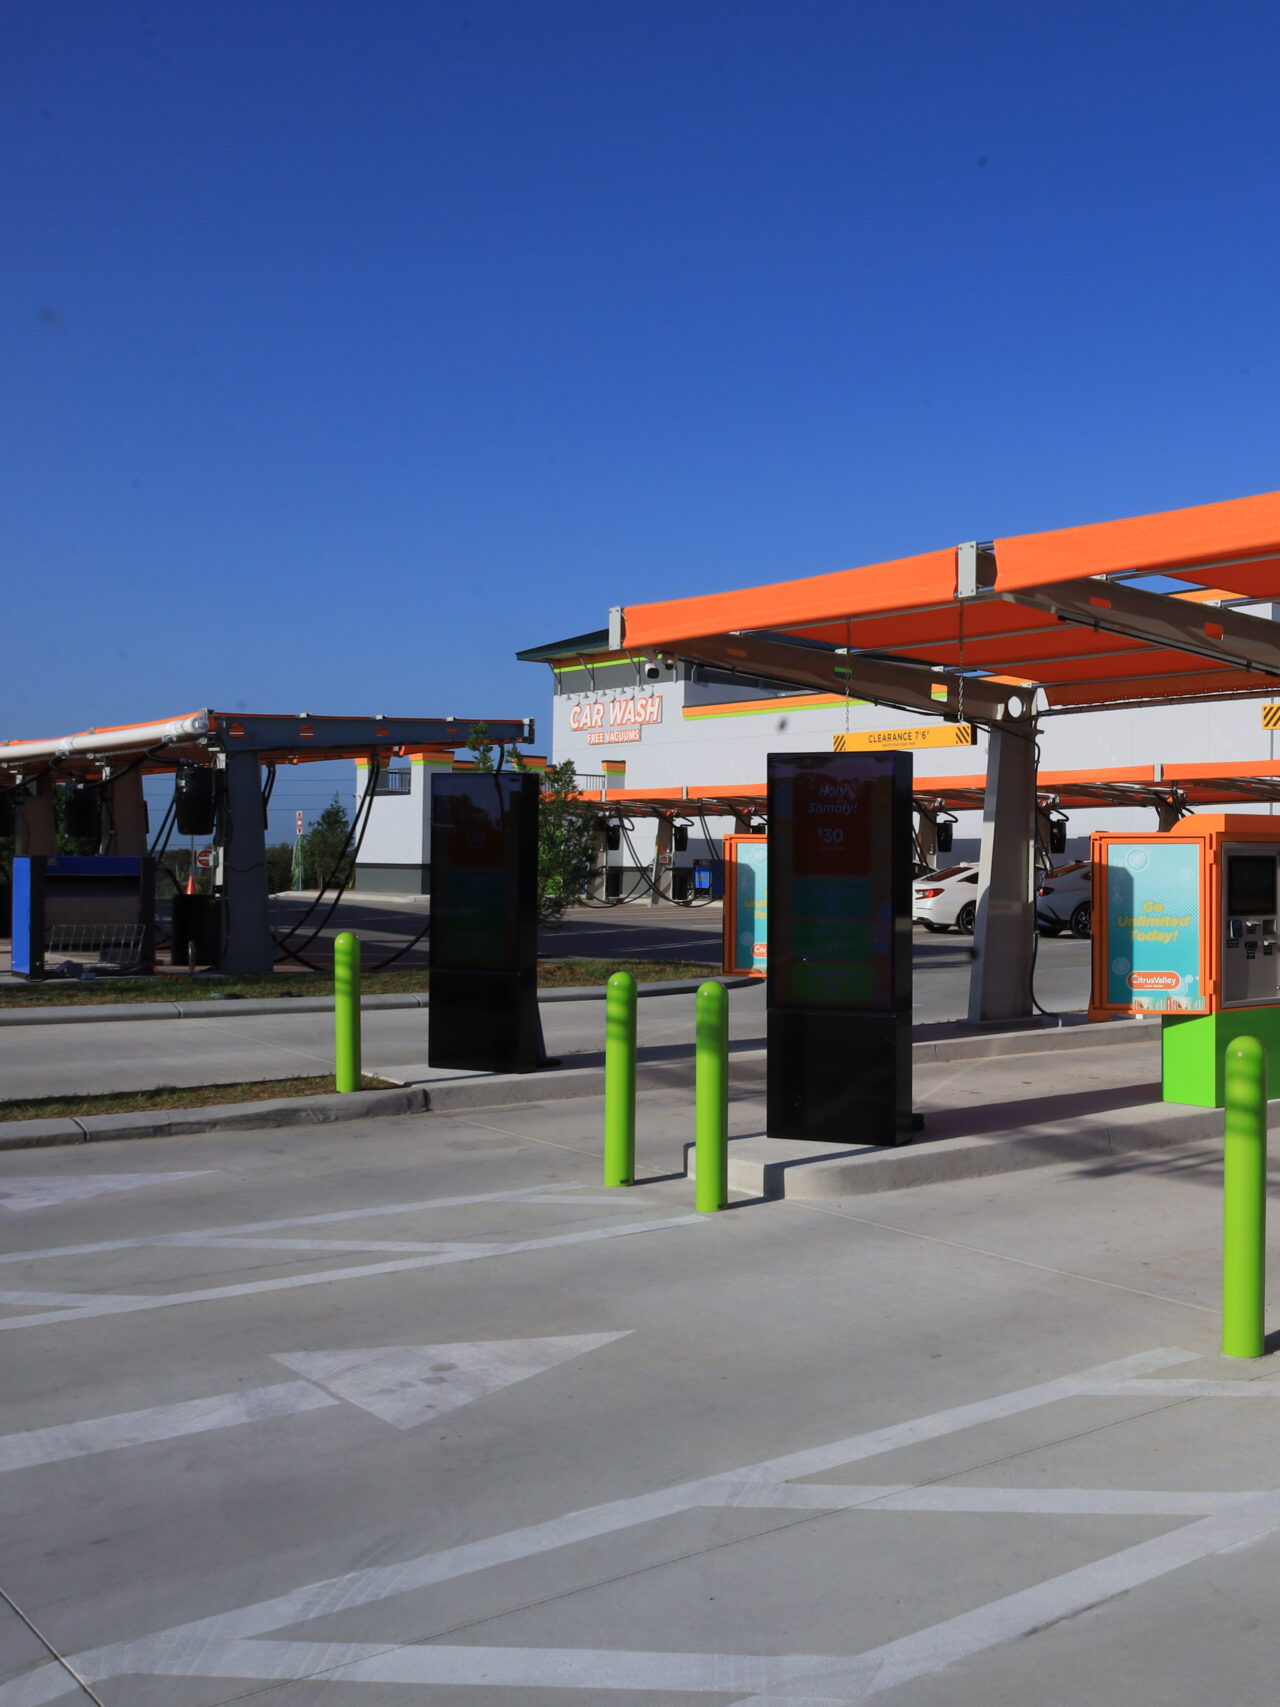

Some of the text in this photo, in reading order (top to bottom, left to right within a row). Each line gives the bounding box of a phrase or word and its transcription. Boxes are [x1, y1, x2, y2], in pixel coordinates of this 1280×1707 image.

[570, 696, 662, 731] CAR WASH
[587, 729, 640, 745] FREE VACUUMS
[868, 732, 912, 743] CLEARANCE
[1142, 900, 1163, 912] Go
[1118, 914, 1191, 927] Unlimited
[1130, 929, 1179, 944] Today!
